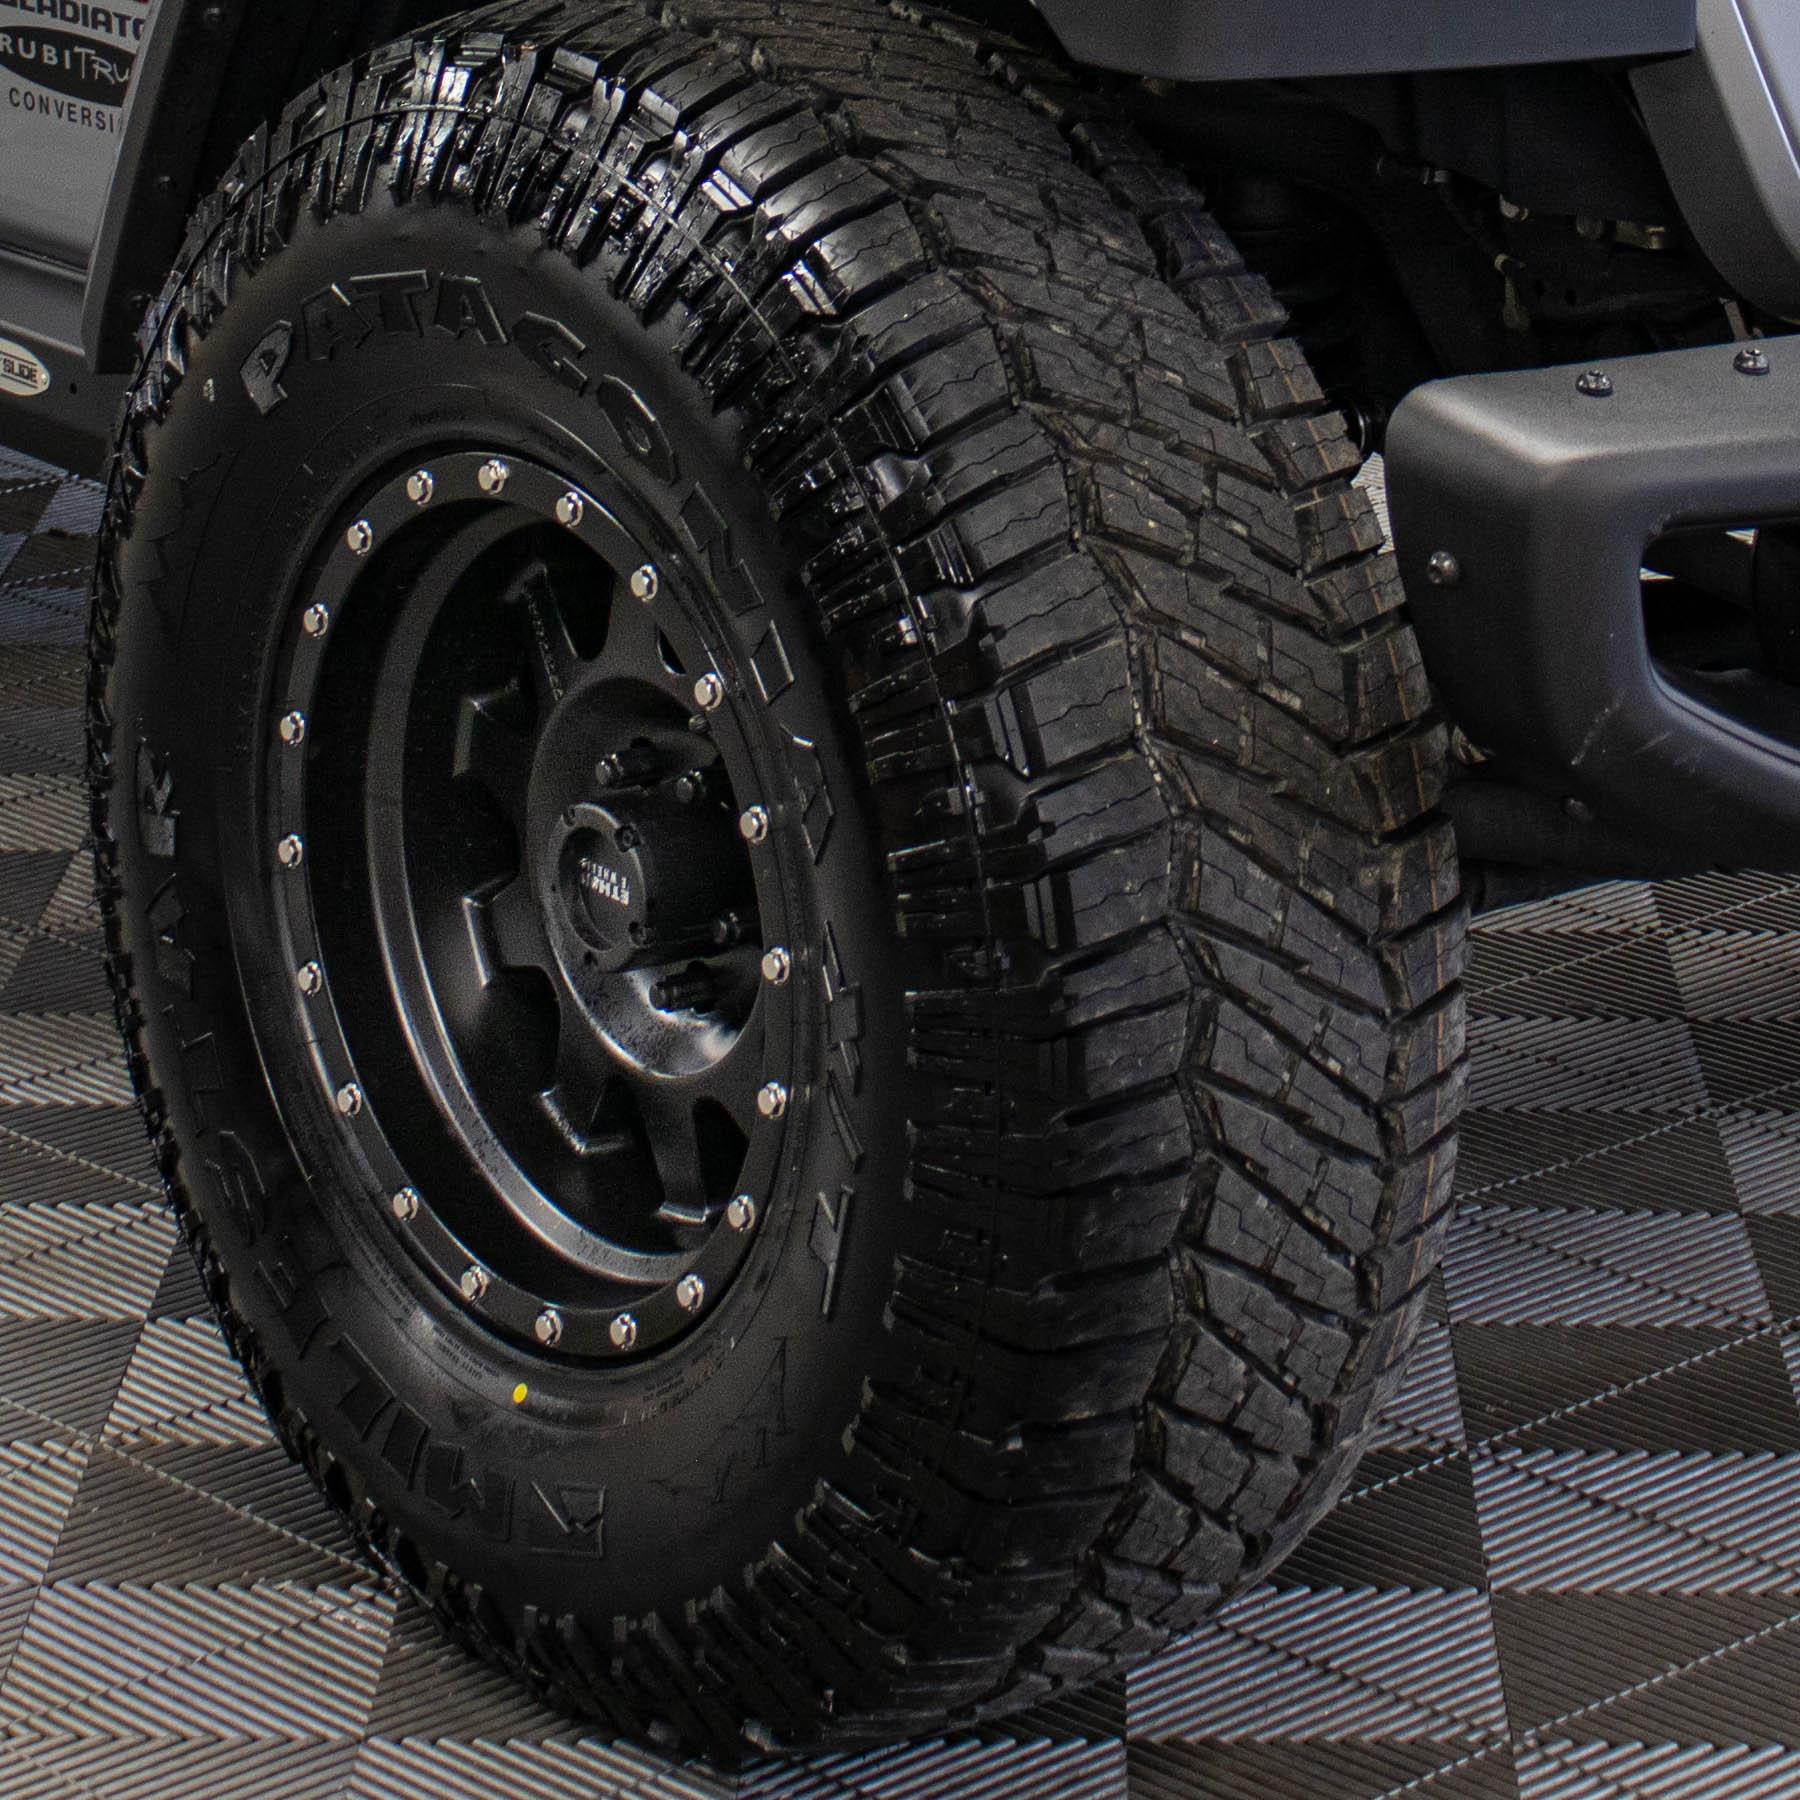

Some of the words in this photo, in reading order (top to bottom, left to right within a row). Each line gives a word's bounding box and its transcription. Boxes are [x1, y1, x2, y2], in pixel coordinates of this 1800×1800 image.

[8, 87, 122, 134] CONVERSI
[2, 358, 39, 384] SLIDE
[238, 268, 834, 866] PATAGONIA
